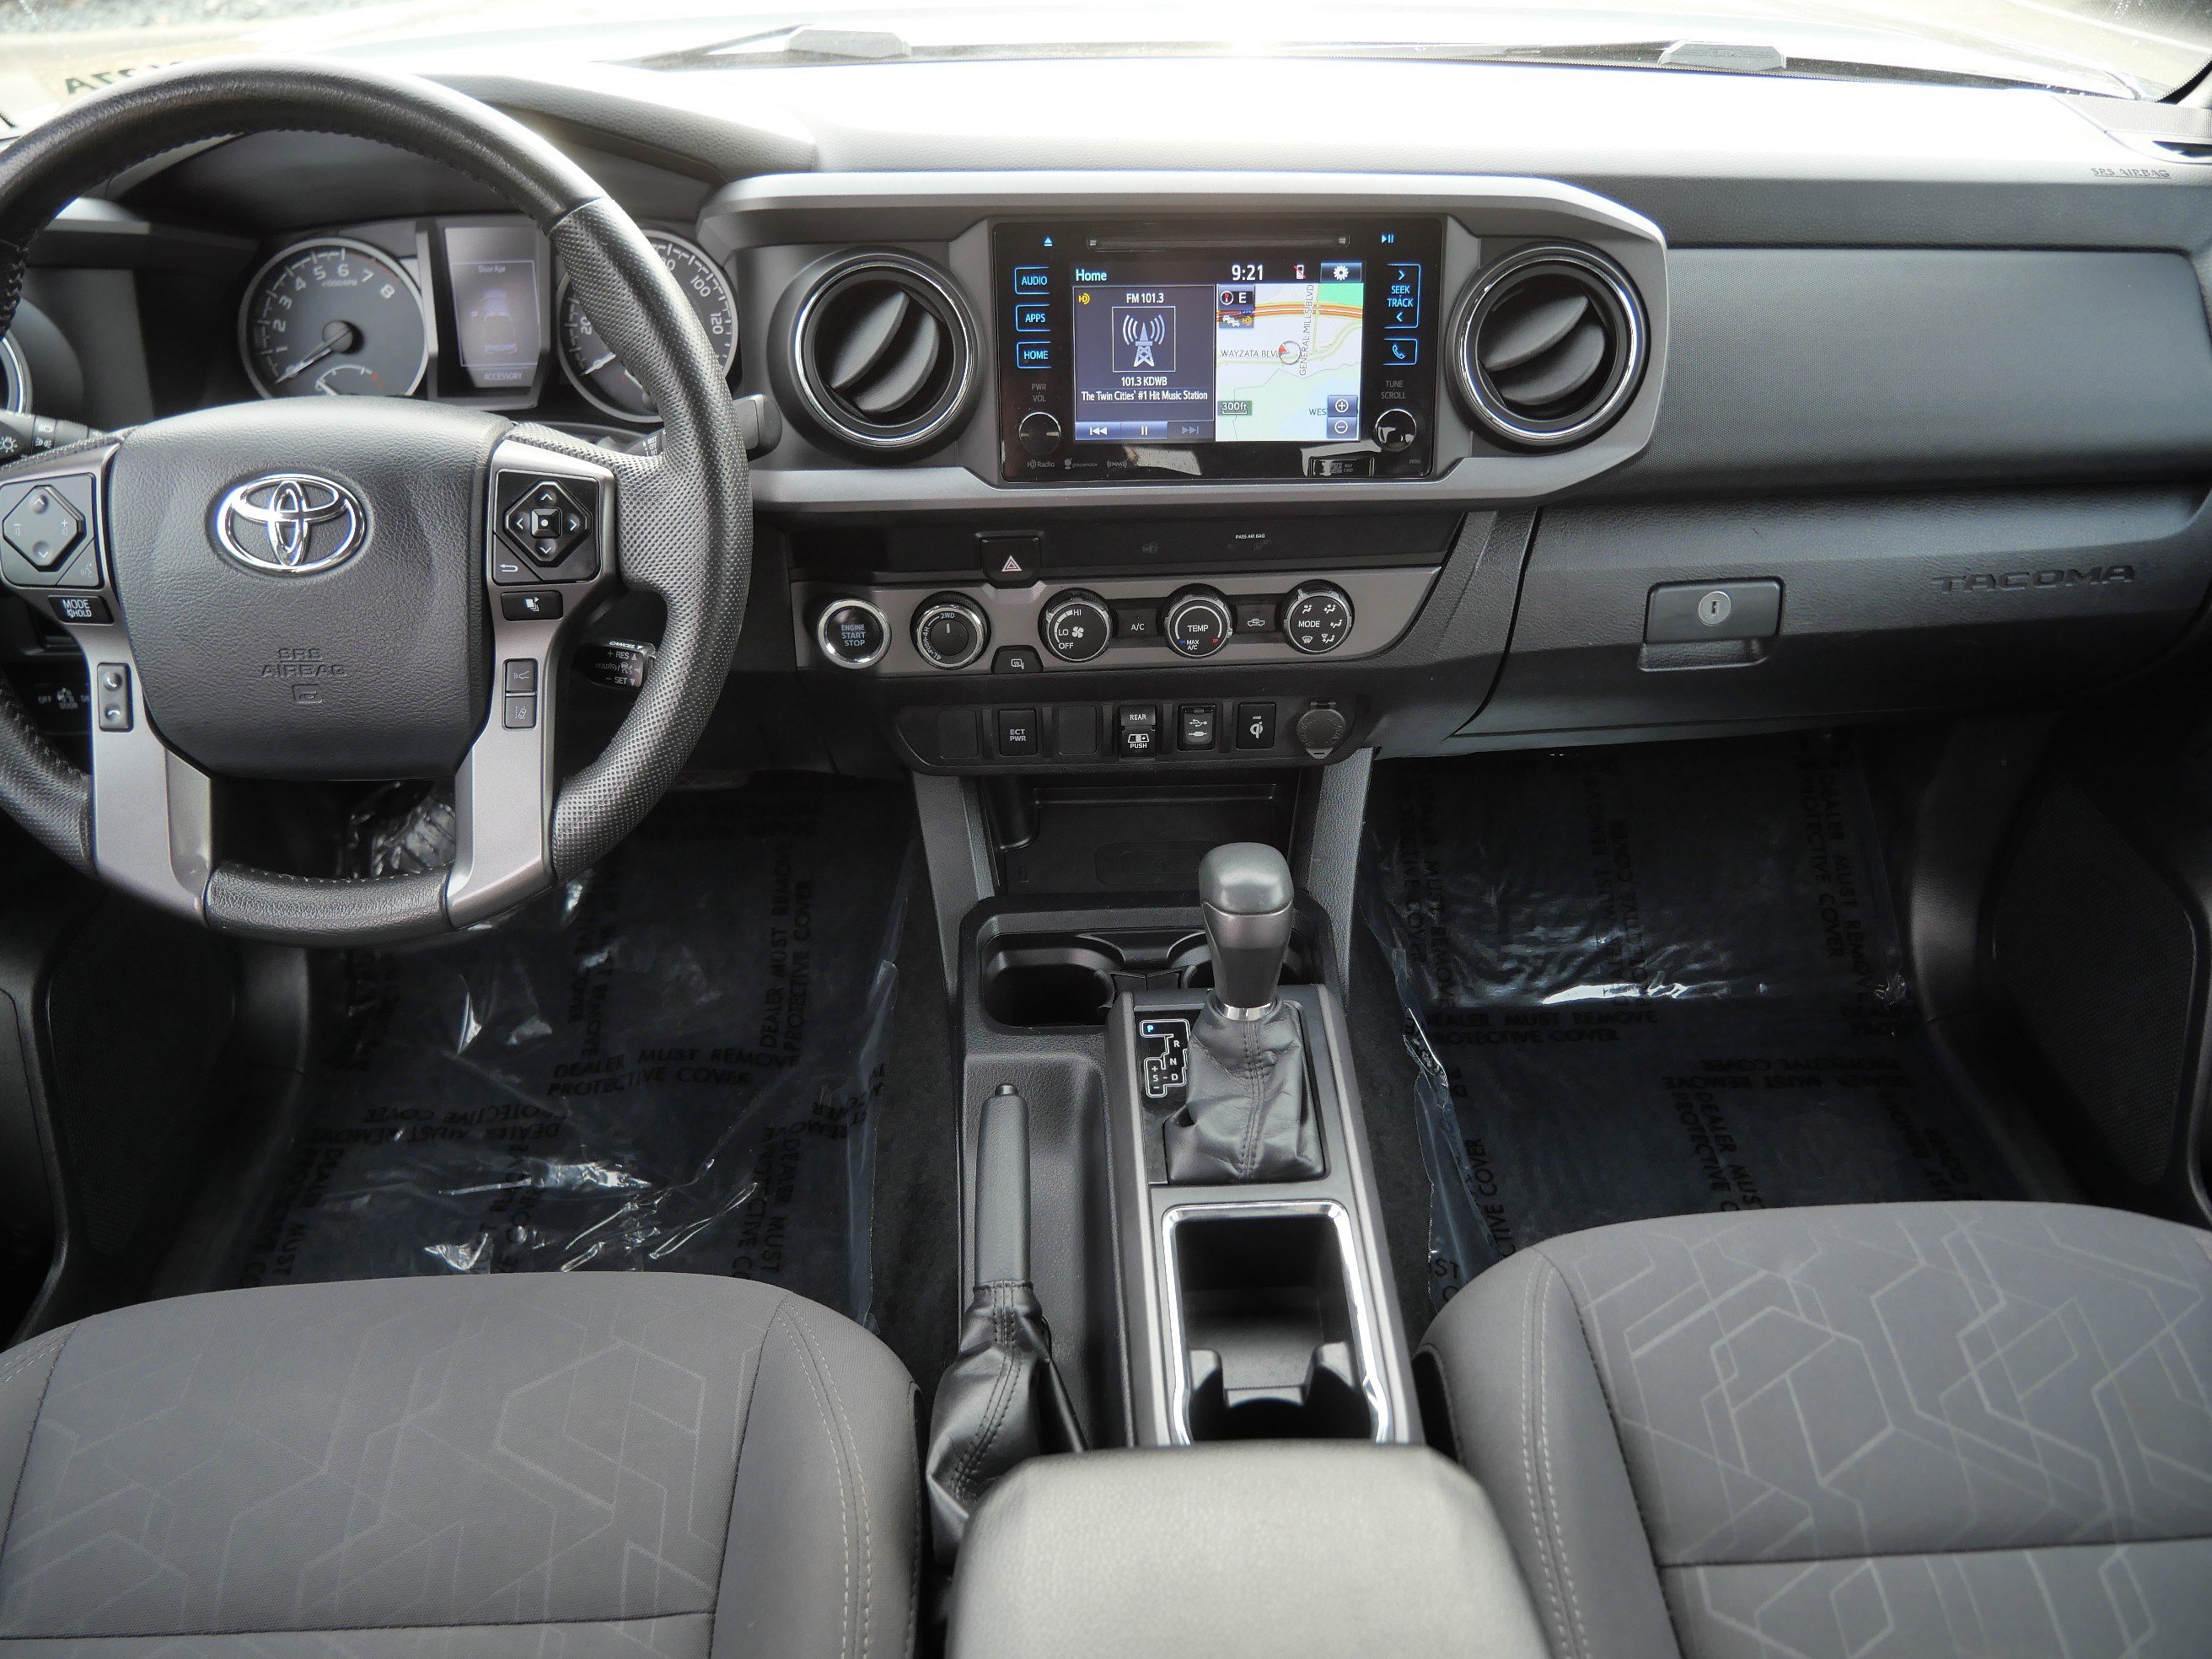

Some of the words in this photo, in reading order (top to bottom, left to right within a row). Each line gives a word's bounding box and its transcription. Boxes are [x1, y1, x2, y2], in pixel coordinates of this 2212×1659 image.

[2091, 168, 2115, 176] SRS
[2119, 169, 2171, 178] AIRBAG
[313, 266, 327, 281] 5
[338, 264, 350, 276] 6
[362, 268, 375, 282] 7
[1076, 269, 1108, 281] Home
[1232, 265, 1264, 282] 9:21
[295, 276, 307, 291] 4
[690, 275, 711, 298] 100
[1021, 276, 1048, 286] AUDIO
[380, 283, 395, 299] 8
[1305, 284, 1315, 307] BLVD
[1391, 285, 1410, 294] SEEK
[278, 295, 293, 310] 3
[1126, 293, 1140, 303] FM
[1141, 293, 1164, 303] 101.3
[1238, 293, 1248, 303] E
[1387, 298, 1414, 308] TRACK
[272, 319, 287, 332] 2
[710, 312, 724, 335] 120
[1025, 313, 1046, 323] APPS
[1302, 309, 1313, 335] MILLS
[1023, 351, 1049, 360] HOME
[1221, 350, 1259, 358] WAYZATA
[1299, 335, 1311, 376] GENERAL
[484, 372, 523, 380] ACCESSORY
[1121, 377, 1142, 386] 101.3
[1143, 377, 1168, 386] KDWB
[1032, 395, 1047, 403] VOL
[1082, 391, 1095, 400] The
[1096, 391, 1113, 400] Twin
[1114, 390, 1136, 400] Cities'
[1138, 391, 1147, 400] #1
[1149, 391, 1161, 400] Hit
[1162, 391, 1183, 400] Music
[1183, 390, 1208, 400] Station
[1381, 391, 1406, 400] SCROLL
[1221, 402, 1248, 411] 300ft
[1930, 566, 2136, 593] TACOMA
[62, 599, 90, 609] MODE
[73, 609, 92, 618] HOLD
[1130, 623, 1145, 631] A/C
[841, 631, 866, 640] START
[278, 648, 324, 661] SRS
[615, 651, 630, 659] RES
[261, 663, 347, 678] AIRBAG
[614, 676, 628, 685] SET
[770, 840, 795, 916] REMOVE
[1834, 853, 1860, 909] MUST
[794, 878, 813, 942] COVER
[1818, 892, 1845, 959] COVER
[770, 927, 788, 979] MUST
[784, 950, 811, 1052] PROTECTIVE
[760, 986, 785, 1049] DEALER
[1505, 1012, 1560, 1027] MUST
[1573, 1010, 1658, 1025] REMOVE
[1146, 1024, 1154, 1033] P
[1551, 1028, 1620, 1043] COVER
[1173, 1039, 1180, 1048] R
[553, 1054, 625, 1079] DEALER
[638, 1048, 701, 1063] MUST
[711, 1048, 801, 1068] REMOVE
[547, 1066, 667, 1096] PROTECTIVE
[676, 1066, 753, 1085] COVER
[1171, 1073, 1178, 1082] D
[365, 1106, 435, 1124] COVER
[408, 1124, 469, 1143] MUST
[486, 1122, 561, 1141] DEALER
[1671, 1092, 1731, 1193] PROTECTIVE
[1694, 1092, 1737, 1154] DEALER
[1726, 1164, 1766, 1207] MUS
[774, 1137, 801, 1205] DEALER
[1465, 1137, 1498, 1197] COVER
[760, 1216, 787, 1275] MUST
